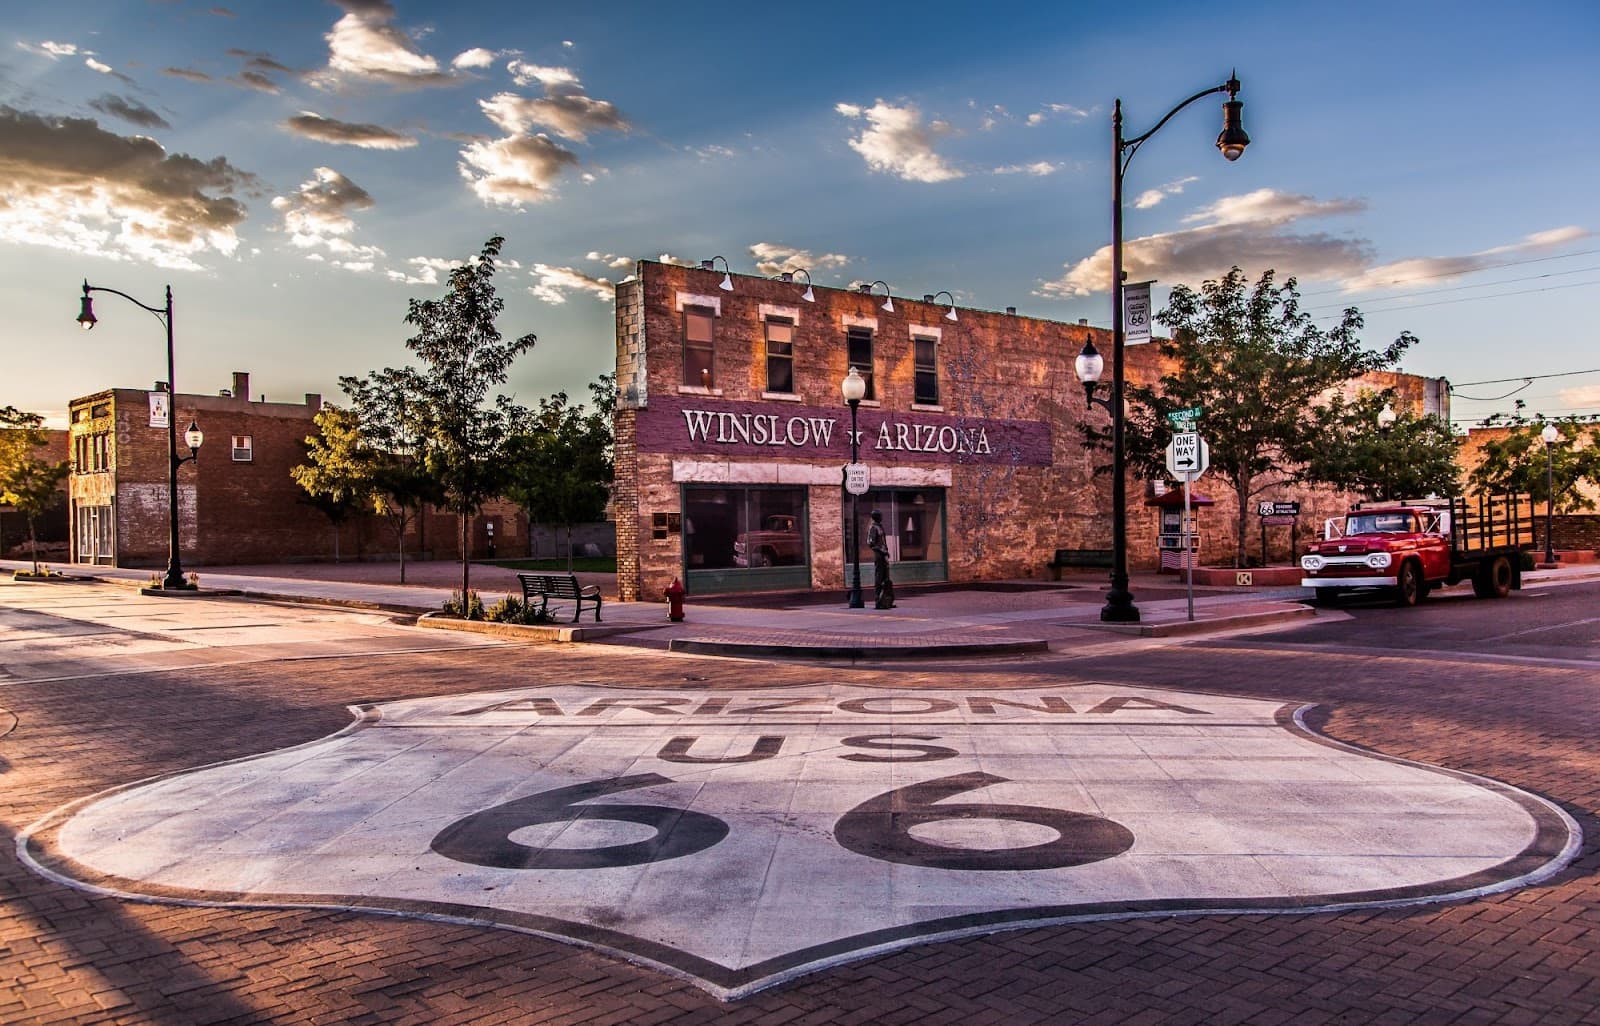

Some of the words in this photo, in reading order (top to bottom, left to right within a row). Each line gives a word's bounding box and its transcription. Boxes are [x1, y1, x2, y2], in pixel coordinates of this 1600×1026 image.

[1131, 313, 1144, 324] 66
[682, 409, 836, 447] WINSLOW
[875, 421, 992, 454] ARIZONA
[1176, 436, 1194, 446] ONE
[1176, 446, 1195, 456] WAY
[1261, 505, 1273, 514] 66
[1239, 573, 1250, 585] K
[450, 696, 1214, 715] ARIZONA
[430, 771, 1136, 869] 66
